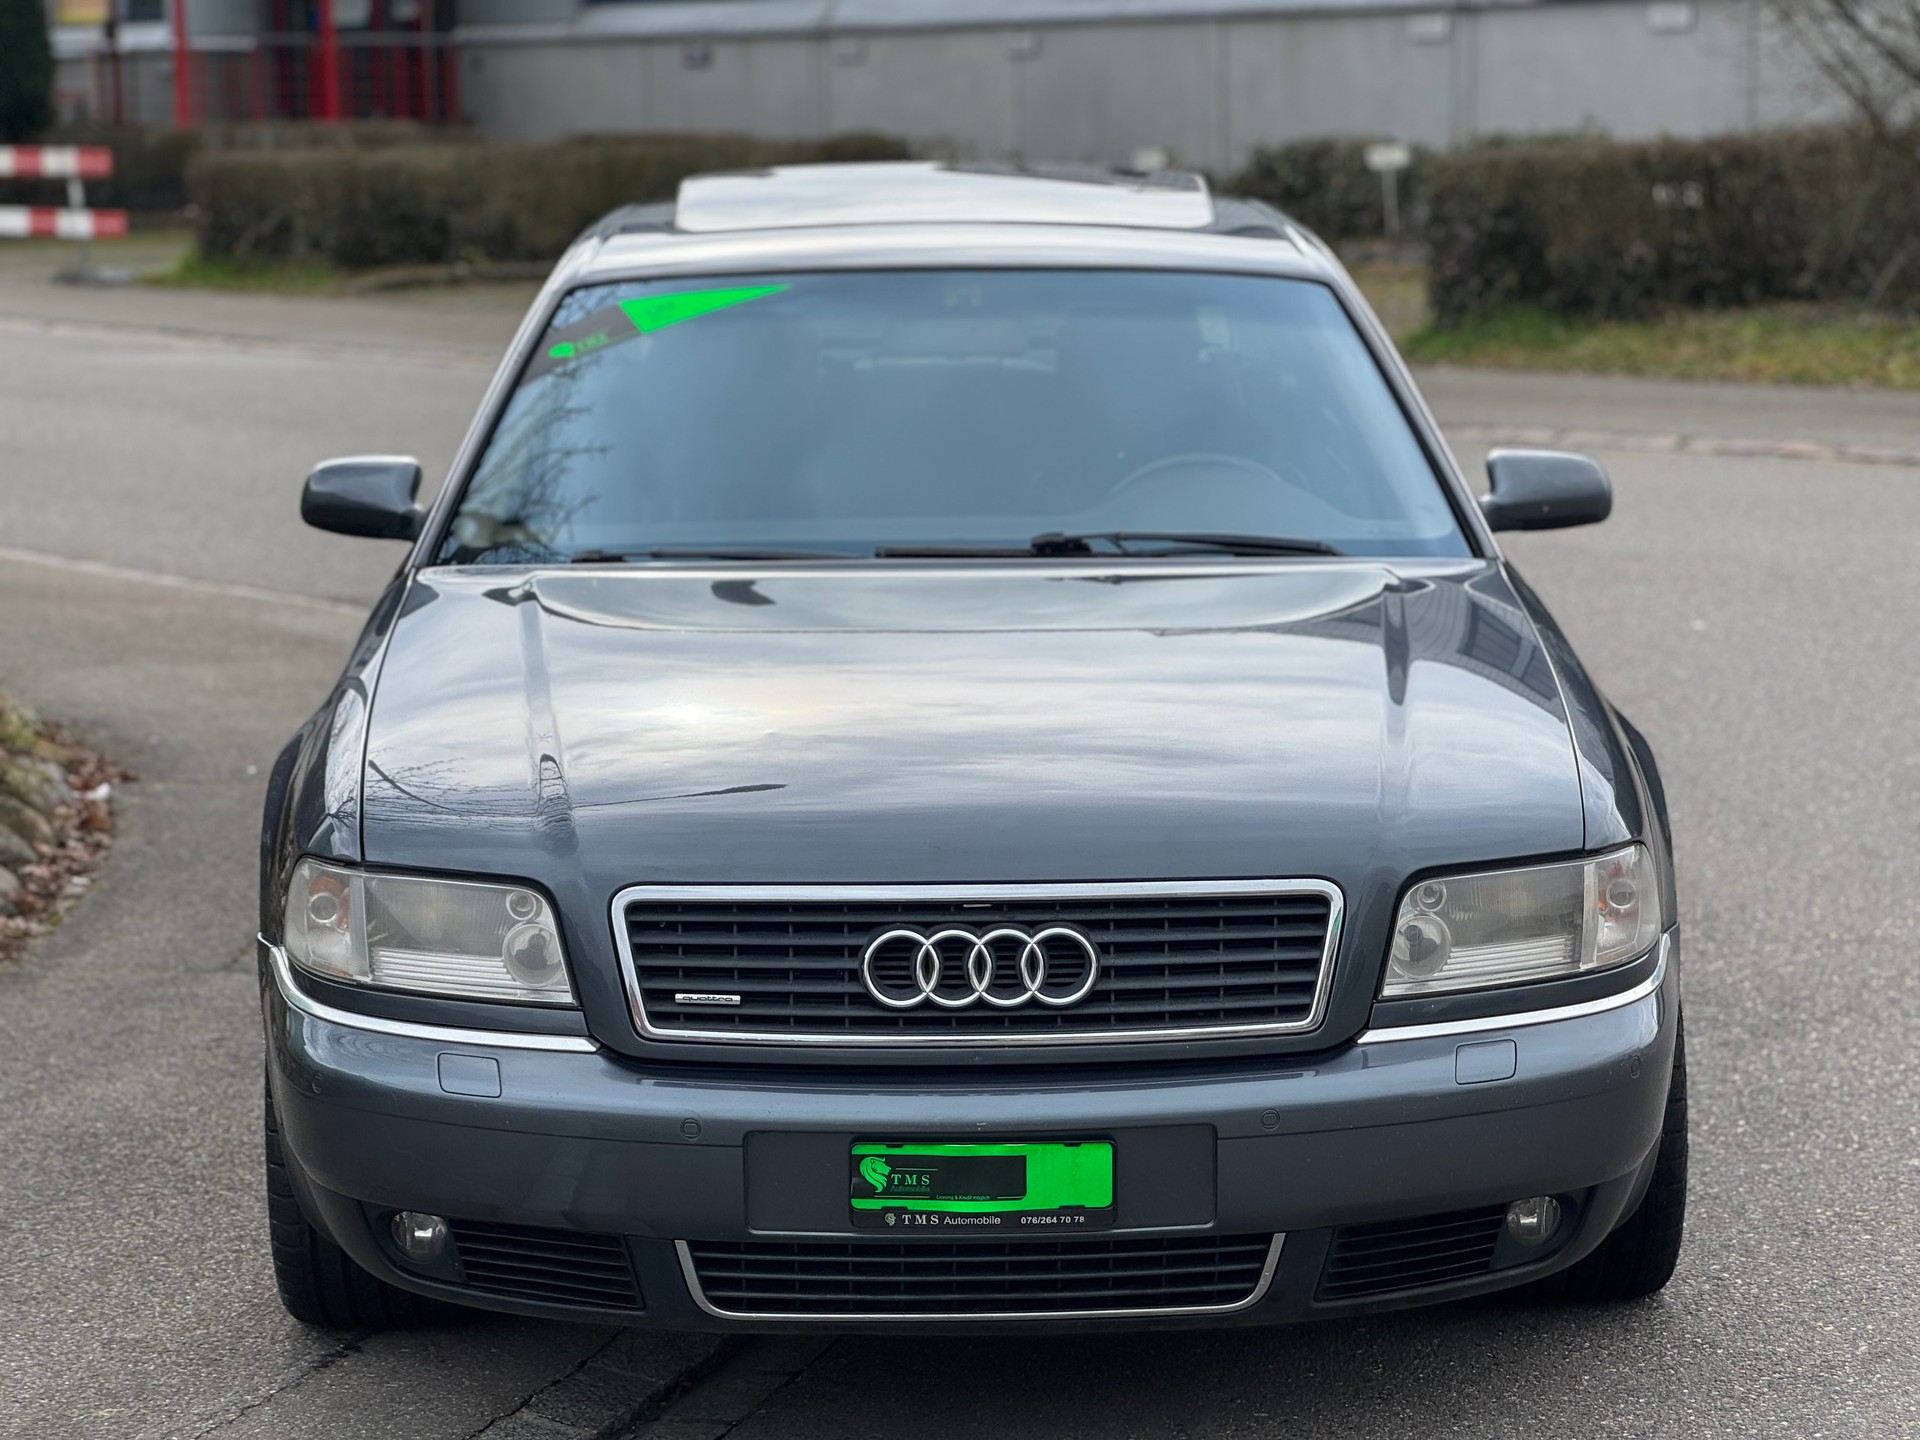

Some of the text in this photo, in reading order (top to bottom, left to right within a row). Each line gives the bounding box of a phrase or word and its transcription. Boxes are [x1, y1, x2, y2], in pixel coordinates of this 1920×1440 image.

[682, 995, 734, 1003] quattro
[890, 1174, 930, 1185] TMS
[902, 1214, 1085, 1225] TMS Automobile 076/264 70 78
